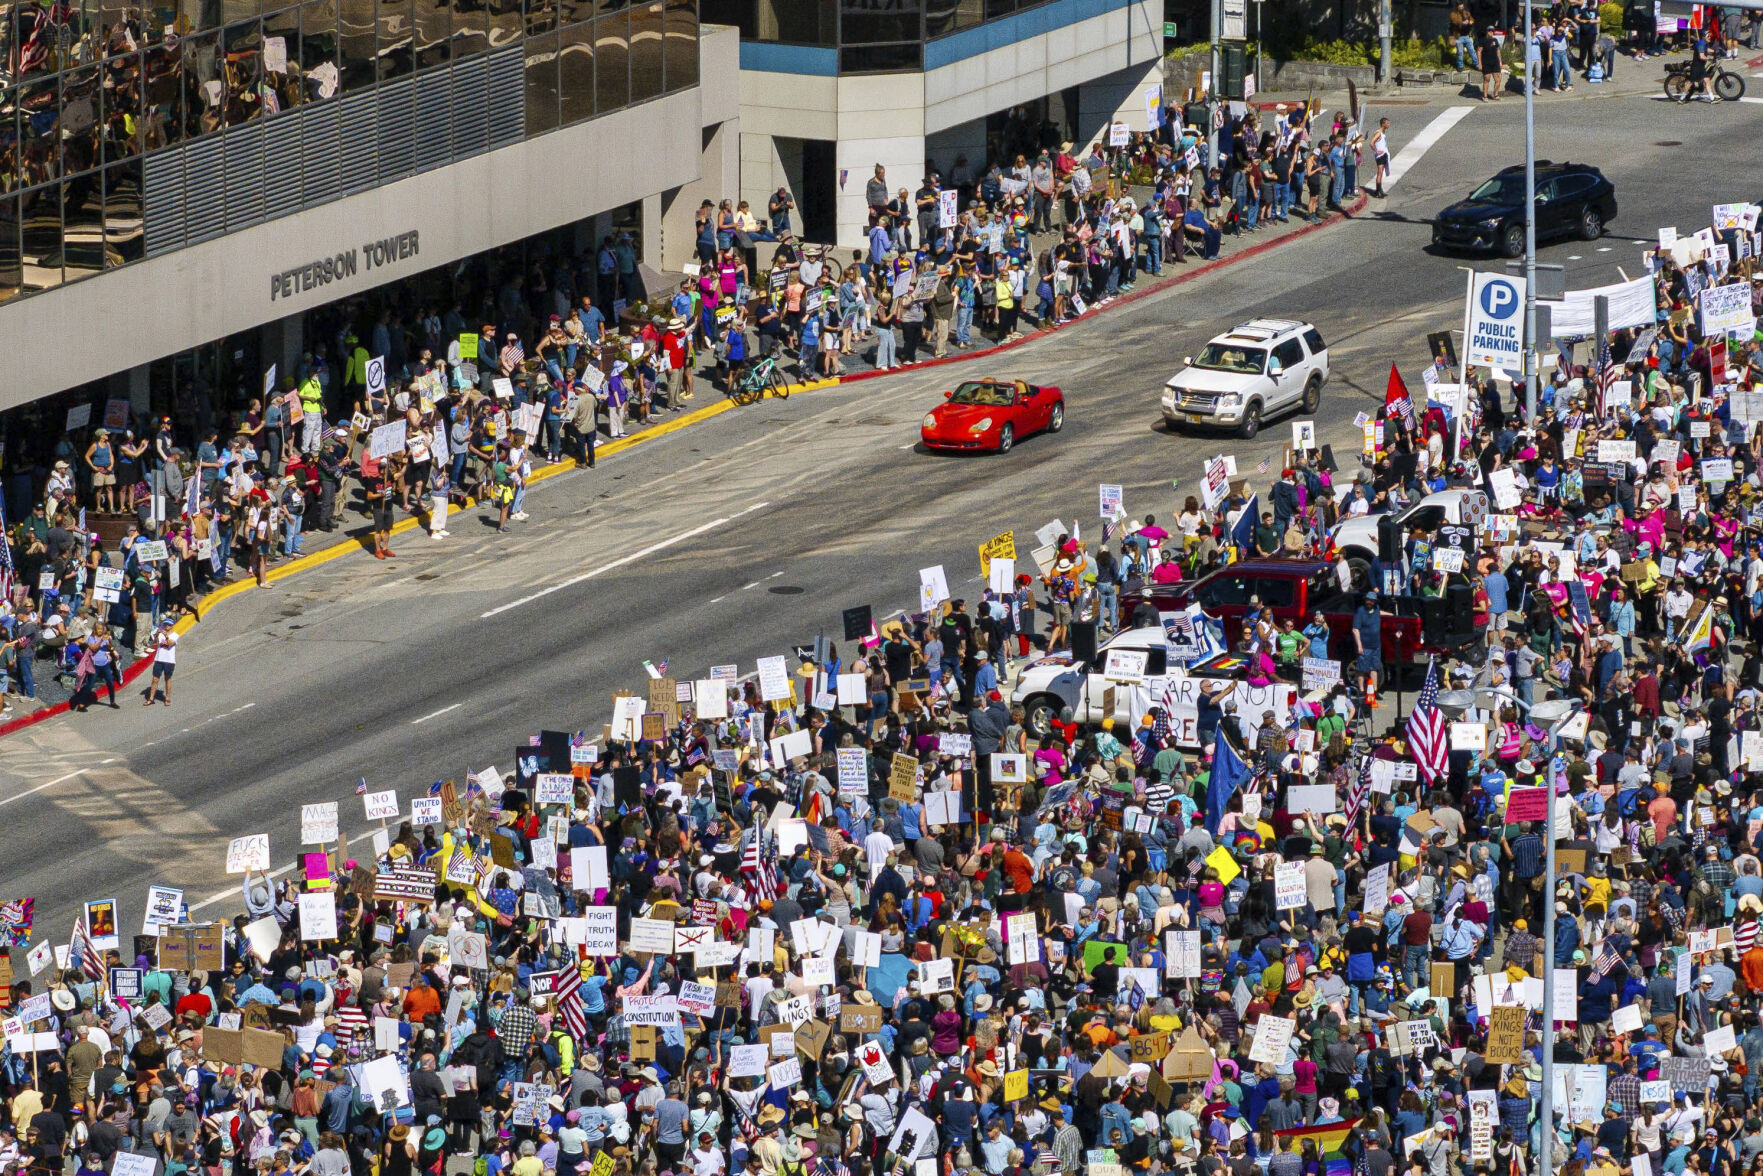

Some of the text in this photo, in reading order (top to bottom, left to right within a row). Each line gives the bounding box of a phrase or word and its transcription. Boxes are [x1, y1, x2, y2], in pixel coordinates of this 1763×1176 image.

[271, 230, 420, 301] PETERSON TOWER
[1489, 284, 1513, 314] P
[1478, 321, 1516, 339] PUBLIC
[1473, 335, 1519, 353] PARKING
[541, 783, 571, 791] KINGS
[371, 794, 389, 805] NO
[540, 793, 571, 802] SALMON
[414, 799, 441, 809] UNITED
[368, 805, 398, 817] KINGS
[420, 807, 431, 816] WE
[416, 815, 440, 824] STAND
[232, 835, 268, 853] FUCK
[1277, 884, 1305, 894] ESSENTIAL
[588, 912, 613, 920] FIGHT
[587, 926, 615, 934] TRUTH
[586, 941, 614, 949] DECAY
[683, 982, 702, 994] PRISON
[628, 996, 664, 1007] PROTECT
[787, 999, 801, 1010] NO
[623, 1011, 676, 1023] CONSTITUTION
[781, 1006, 811, 1022] KINGS
[1492, 1009, 1525, 1020] FIGHT
[1493, 1021, 1521, 1033] KINGS
[1410, 1036, 1433, 1045] SCISM
[1498, 1034, 1514, 1045] NOT
[1134, 1035, 1168, 1057] 8647
[1489, 1046, 1520, 1059] BOOKS
[1006, 1077, 1022, 1088] NO
[1093, 1166, 1115, 1175] OUR
